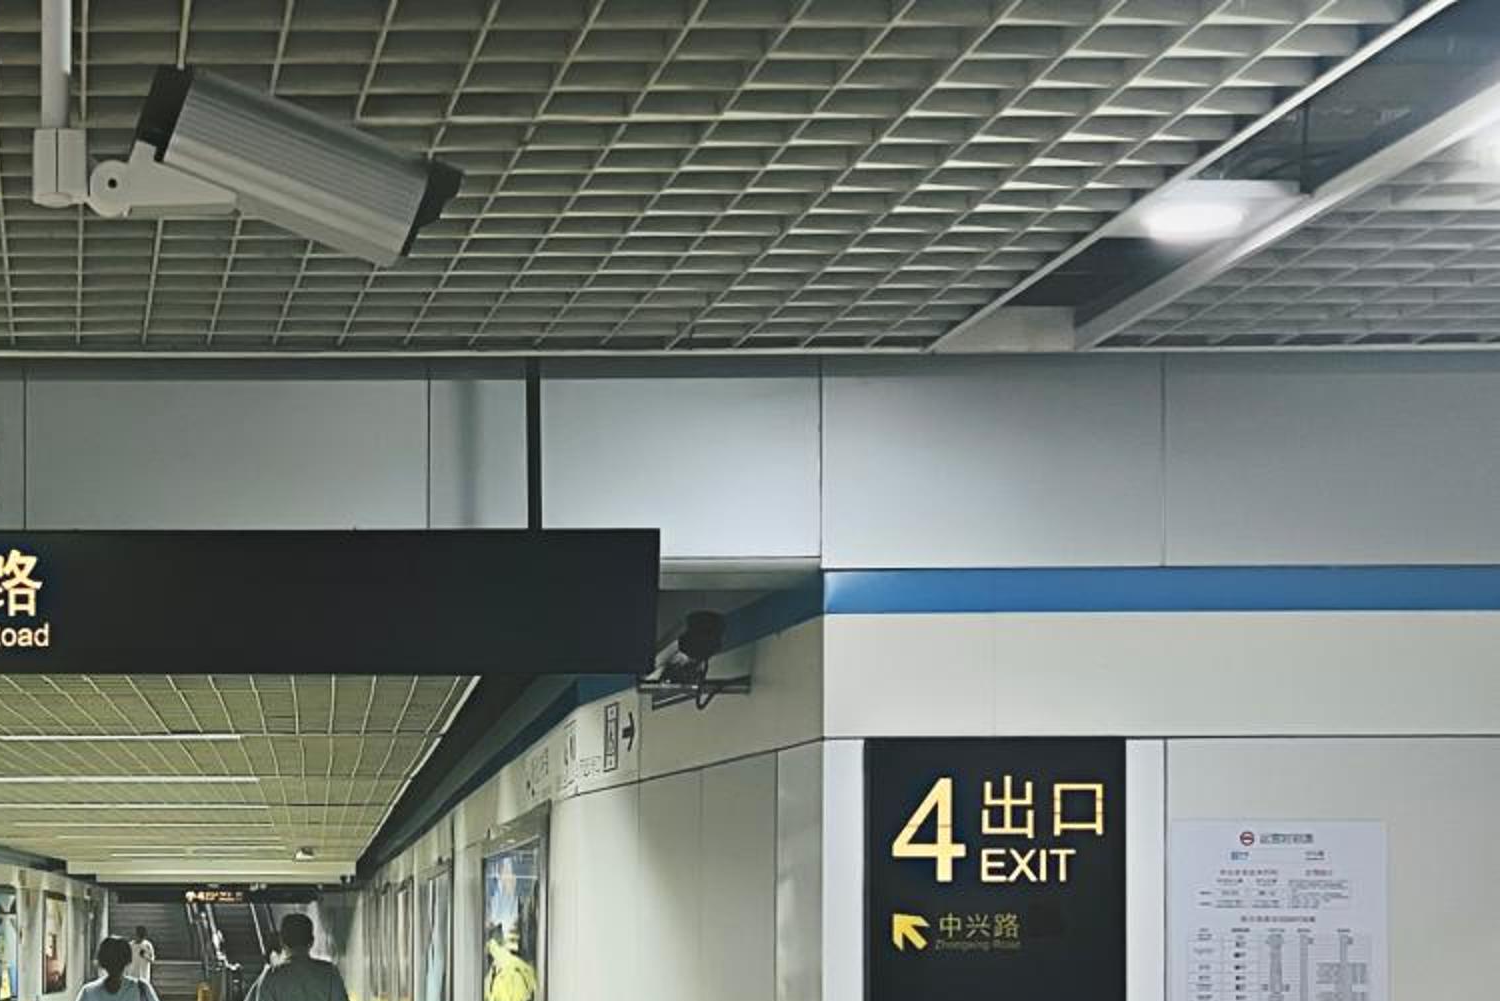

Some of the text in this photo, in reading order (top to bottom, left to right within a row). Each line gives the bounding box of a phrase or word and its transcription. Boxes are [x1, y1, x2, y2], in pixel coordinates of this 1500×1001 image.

[891, 777, 967, 883] 4
[981, 775, 1105, 839] 出口
[980, 848, 1077, 883] EXIT
[939, 912, 1019, 938] 中兴路
